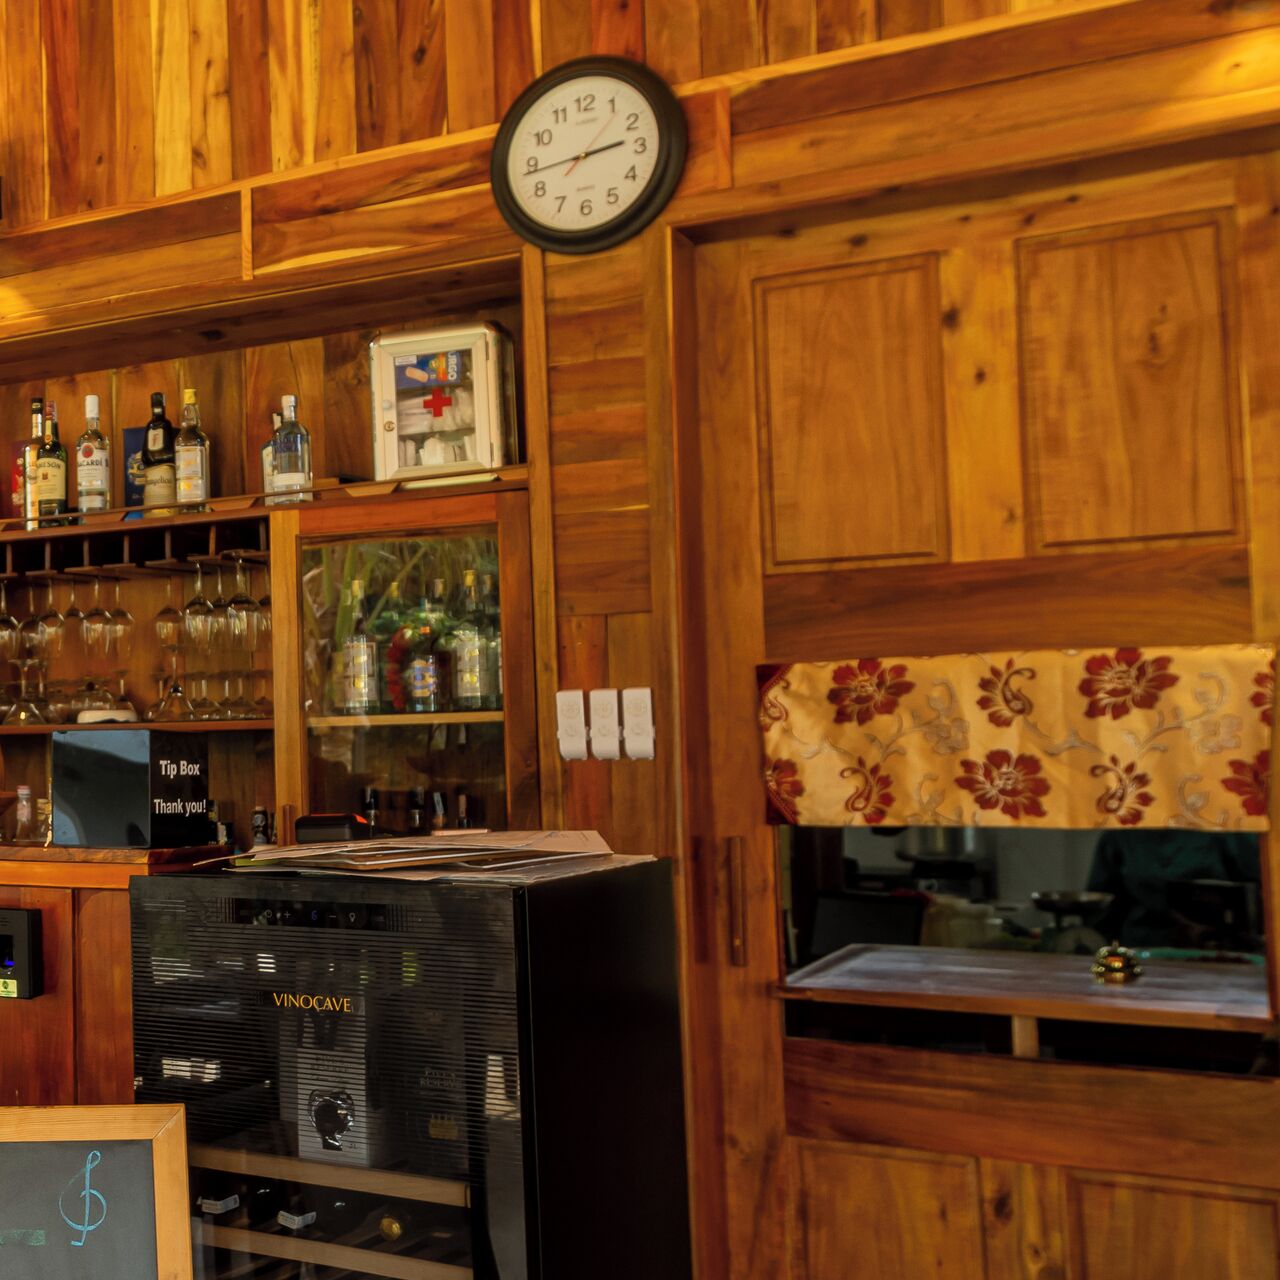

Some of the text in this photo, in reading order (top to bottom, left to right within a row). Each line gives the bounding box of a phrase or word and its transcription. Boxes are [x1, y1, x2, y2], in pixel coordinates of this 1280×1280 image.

[574, 94, 596, 113] 12
[608, 96, 616, 113] 1
[552, 107, 568, 124] 11
[626, 113, 639, 131] 2
[533, 129, 553, 146] 10
[634, 137, 647, 154] 3
[526, 156, 539, 173] 9
[624, 165, 637, 182] 4
[534, 181, 547, 197] 8
[606, 187, 619, 204] 5
[554, 196, 567, 213] 7
[580, 199, 593, 216] 6
[159, 760, 200, 779] Tip Box
[153, 798, 207, 817] Thank you!
[273, 992, 352, 1013] VINOCAVE
